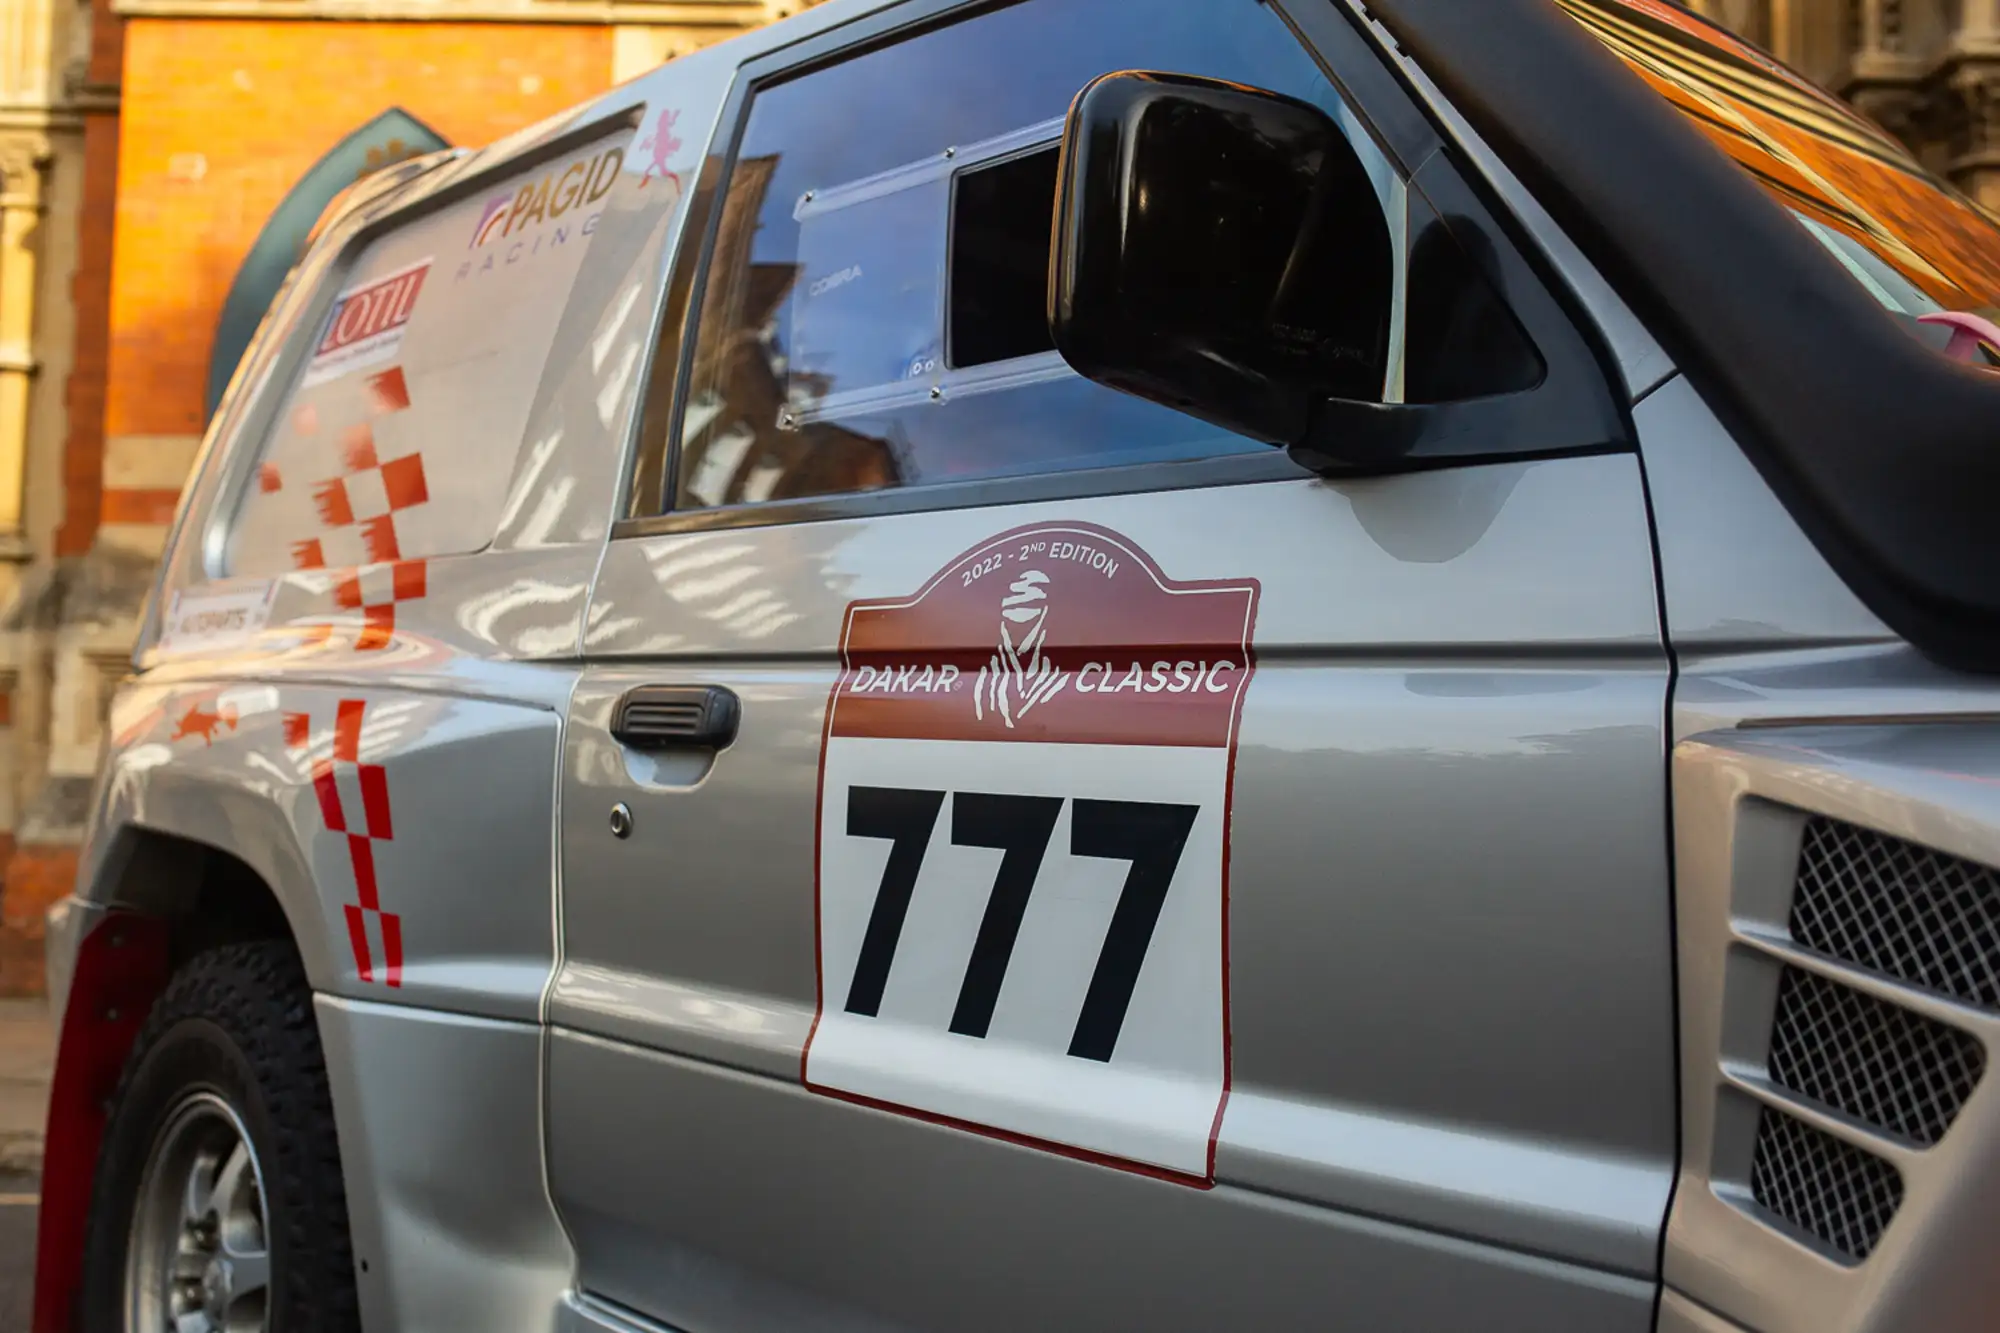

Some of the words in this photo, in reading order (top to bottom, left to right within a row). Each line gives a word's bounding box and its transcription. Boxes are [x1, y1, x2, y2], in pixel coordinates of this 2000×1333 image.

[502, 147, 624, 238] PAGID
[961, 553, 1003, 588] 2022
[1049, 542, 1119, 579] EDITION
[1075, 660, 1236, 693] CLASSIC
[843, 785, 1201, 1063] 777
